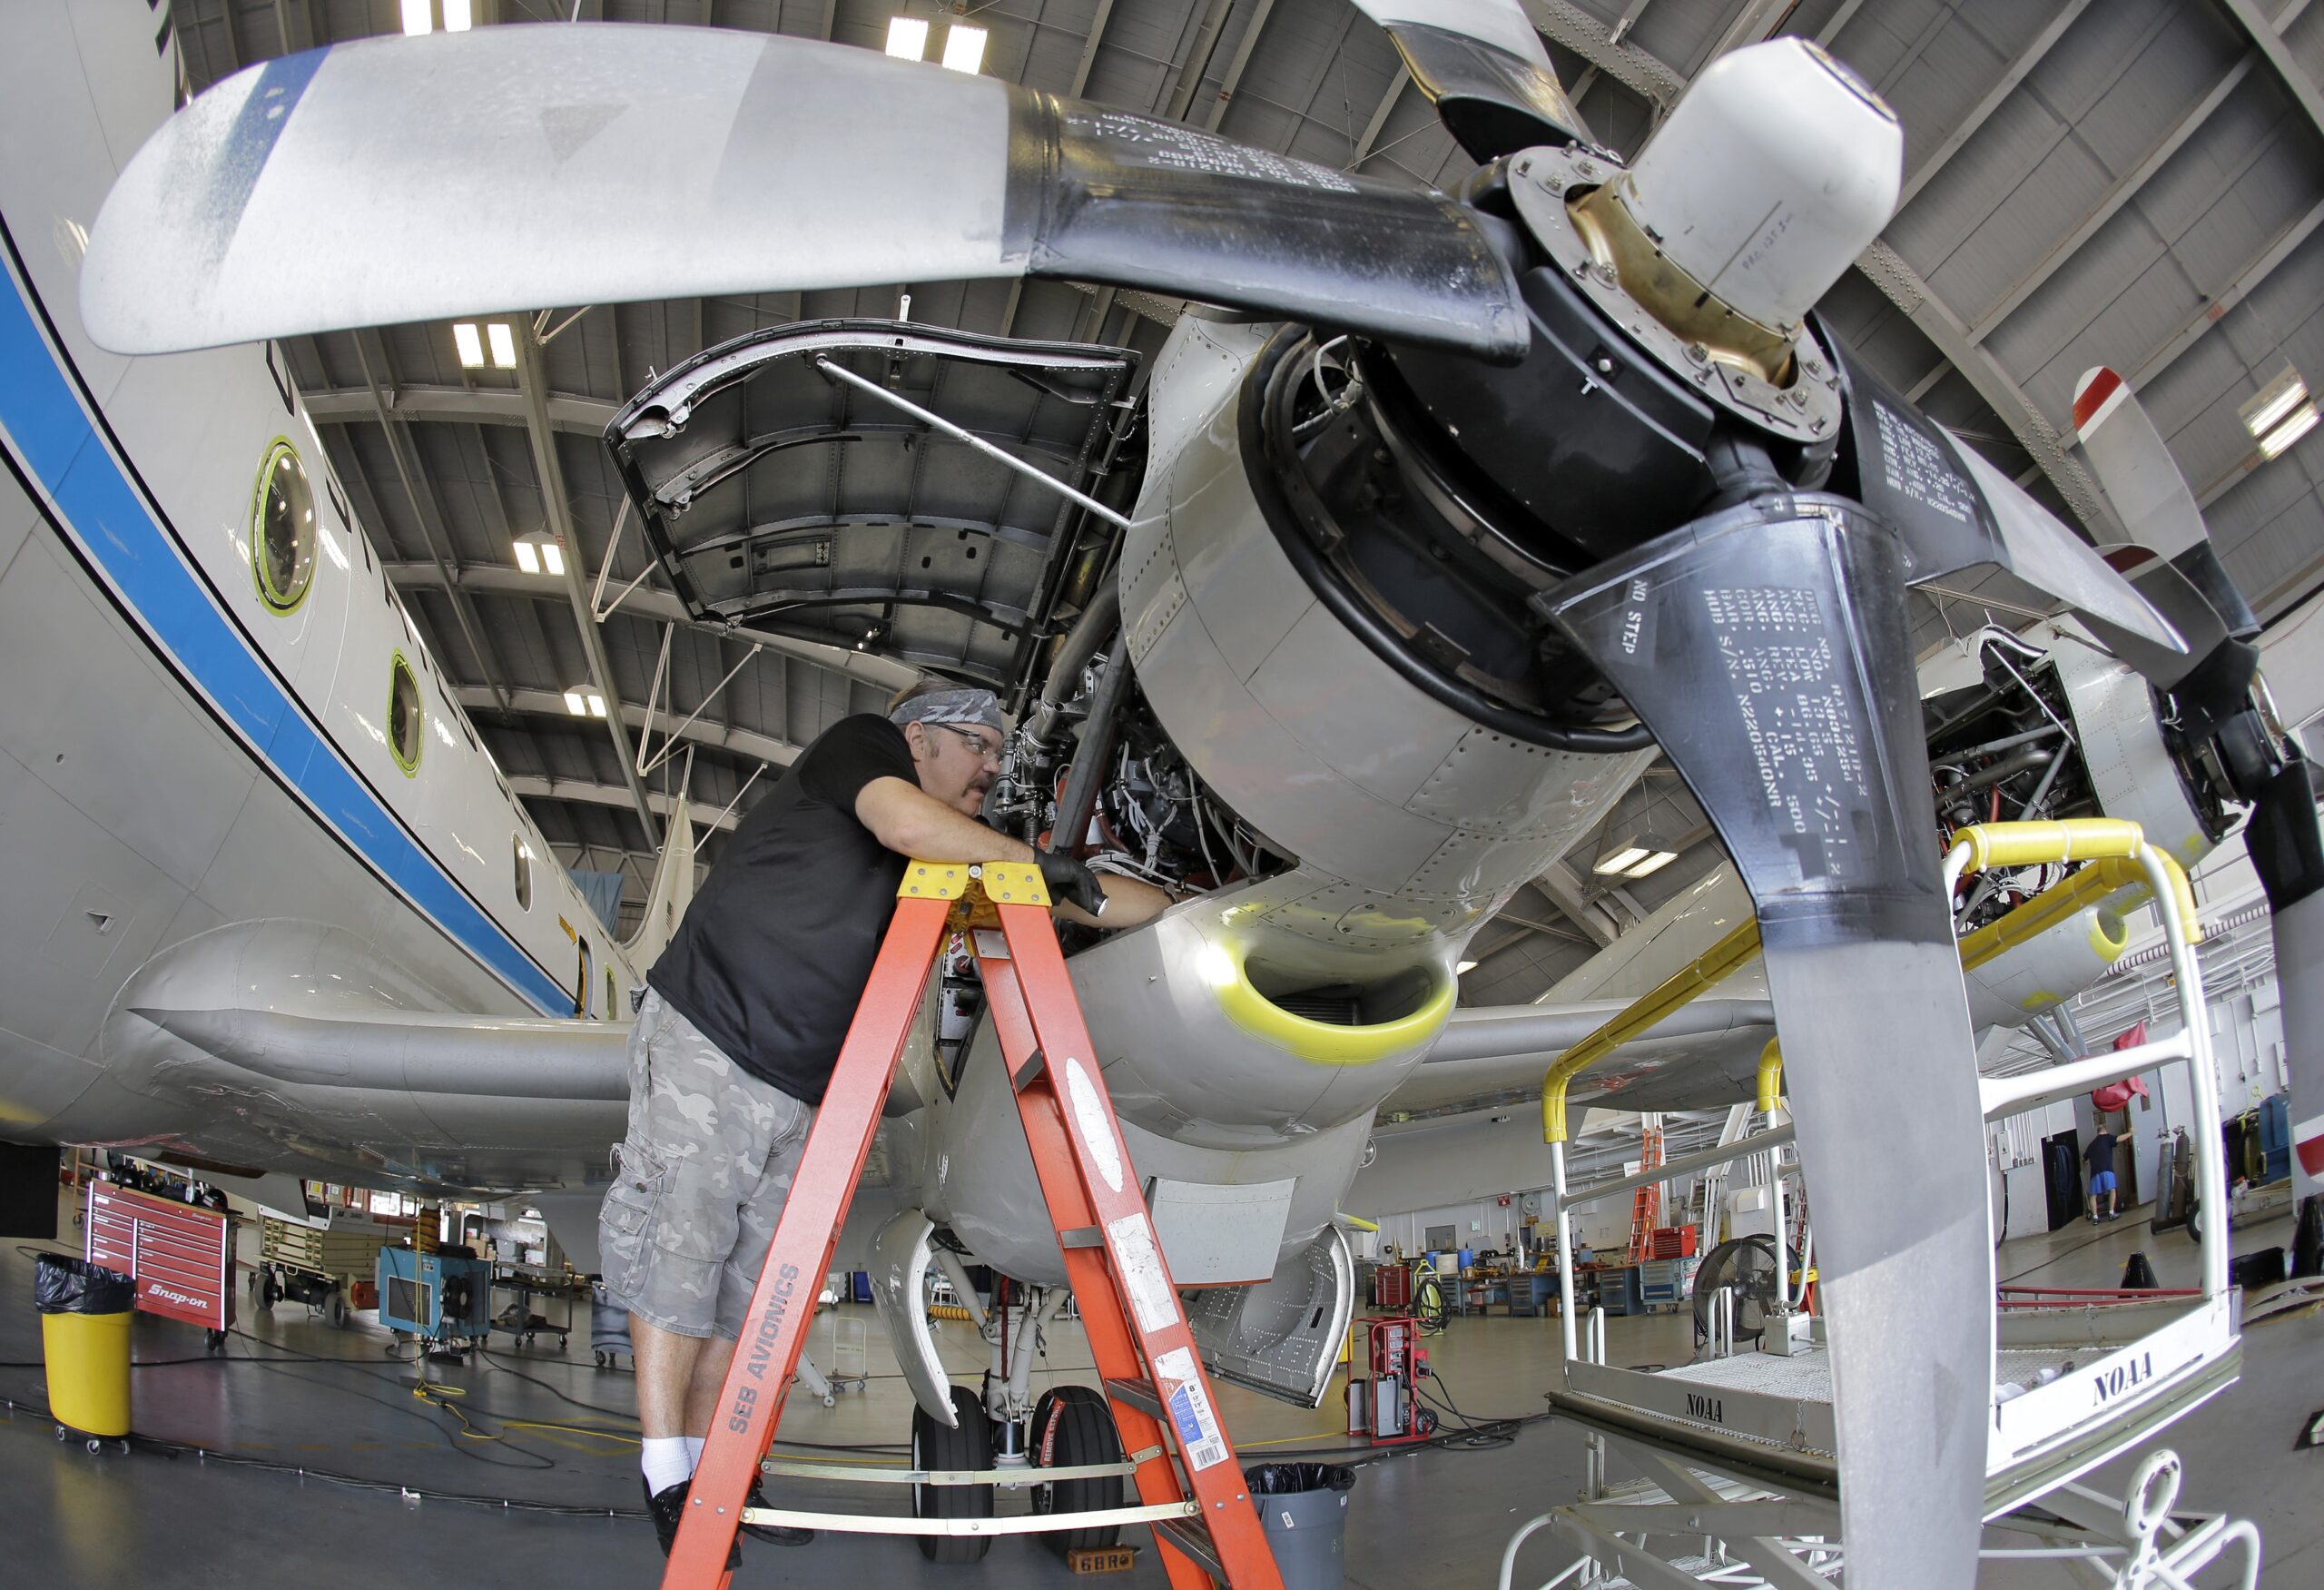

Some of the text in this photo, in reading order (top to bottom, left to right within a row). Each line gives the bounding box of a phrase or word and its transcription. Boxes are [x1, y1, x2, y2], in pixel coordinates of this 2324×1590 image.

[1622, 580, 1648, 654] NO STEP
[1704, 590, 1725, 624] HUB
[1718, 636, 1740, 679] S/N.
[1735, 588, 1754, 630] COR.
[1754, 647, 1774, 690] ANG.
[1750, 590, 1769, 631] ANG.
[1768, 647, 1787, 690] REV.
[1764, 589, 1783, 631] ANG.
[1781, 647, 1801, 682] FEA
[1817, 637, 1831, 668] NO.
[1778, 590, 1833, 744] ANG. LOW 13.5
[1809, 648, 1823, 680] NO.
[1719, 589, 1739, 631] BAR.
[1766, 732, 1785, 778] CAL.
[1787, 795, 1806, 833] 500
[148, 1284, 208, 1309] Snap-on
[729, 1263, 800, 1434] SEB AVIONICS
[2093, 1351, 2152, 1407] NOAA
[1044, 1432, 1055, 1462] REMOVE
[1686, 1393, 1724, 1424] NOAA
